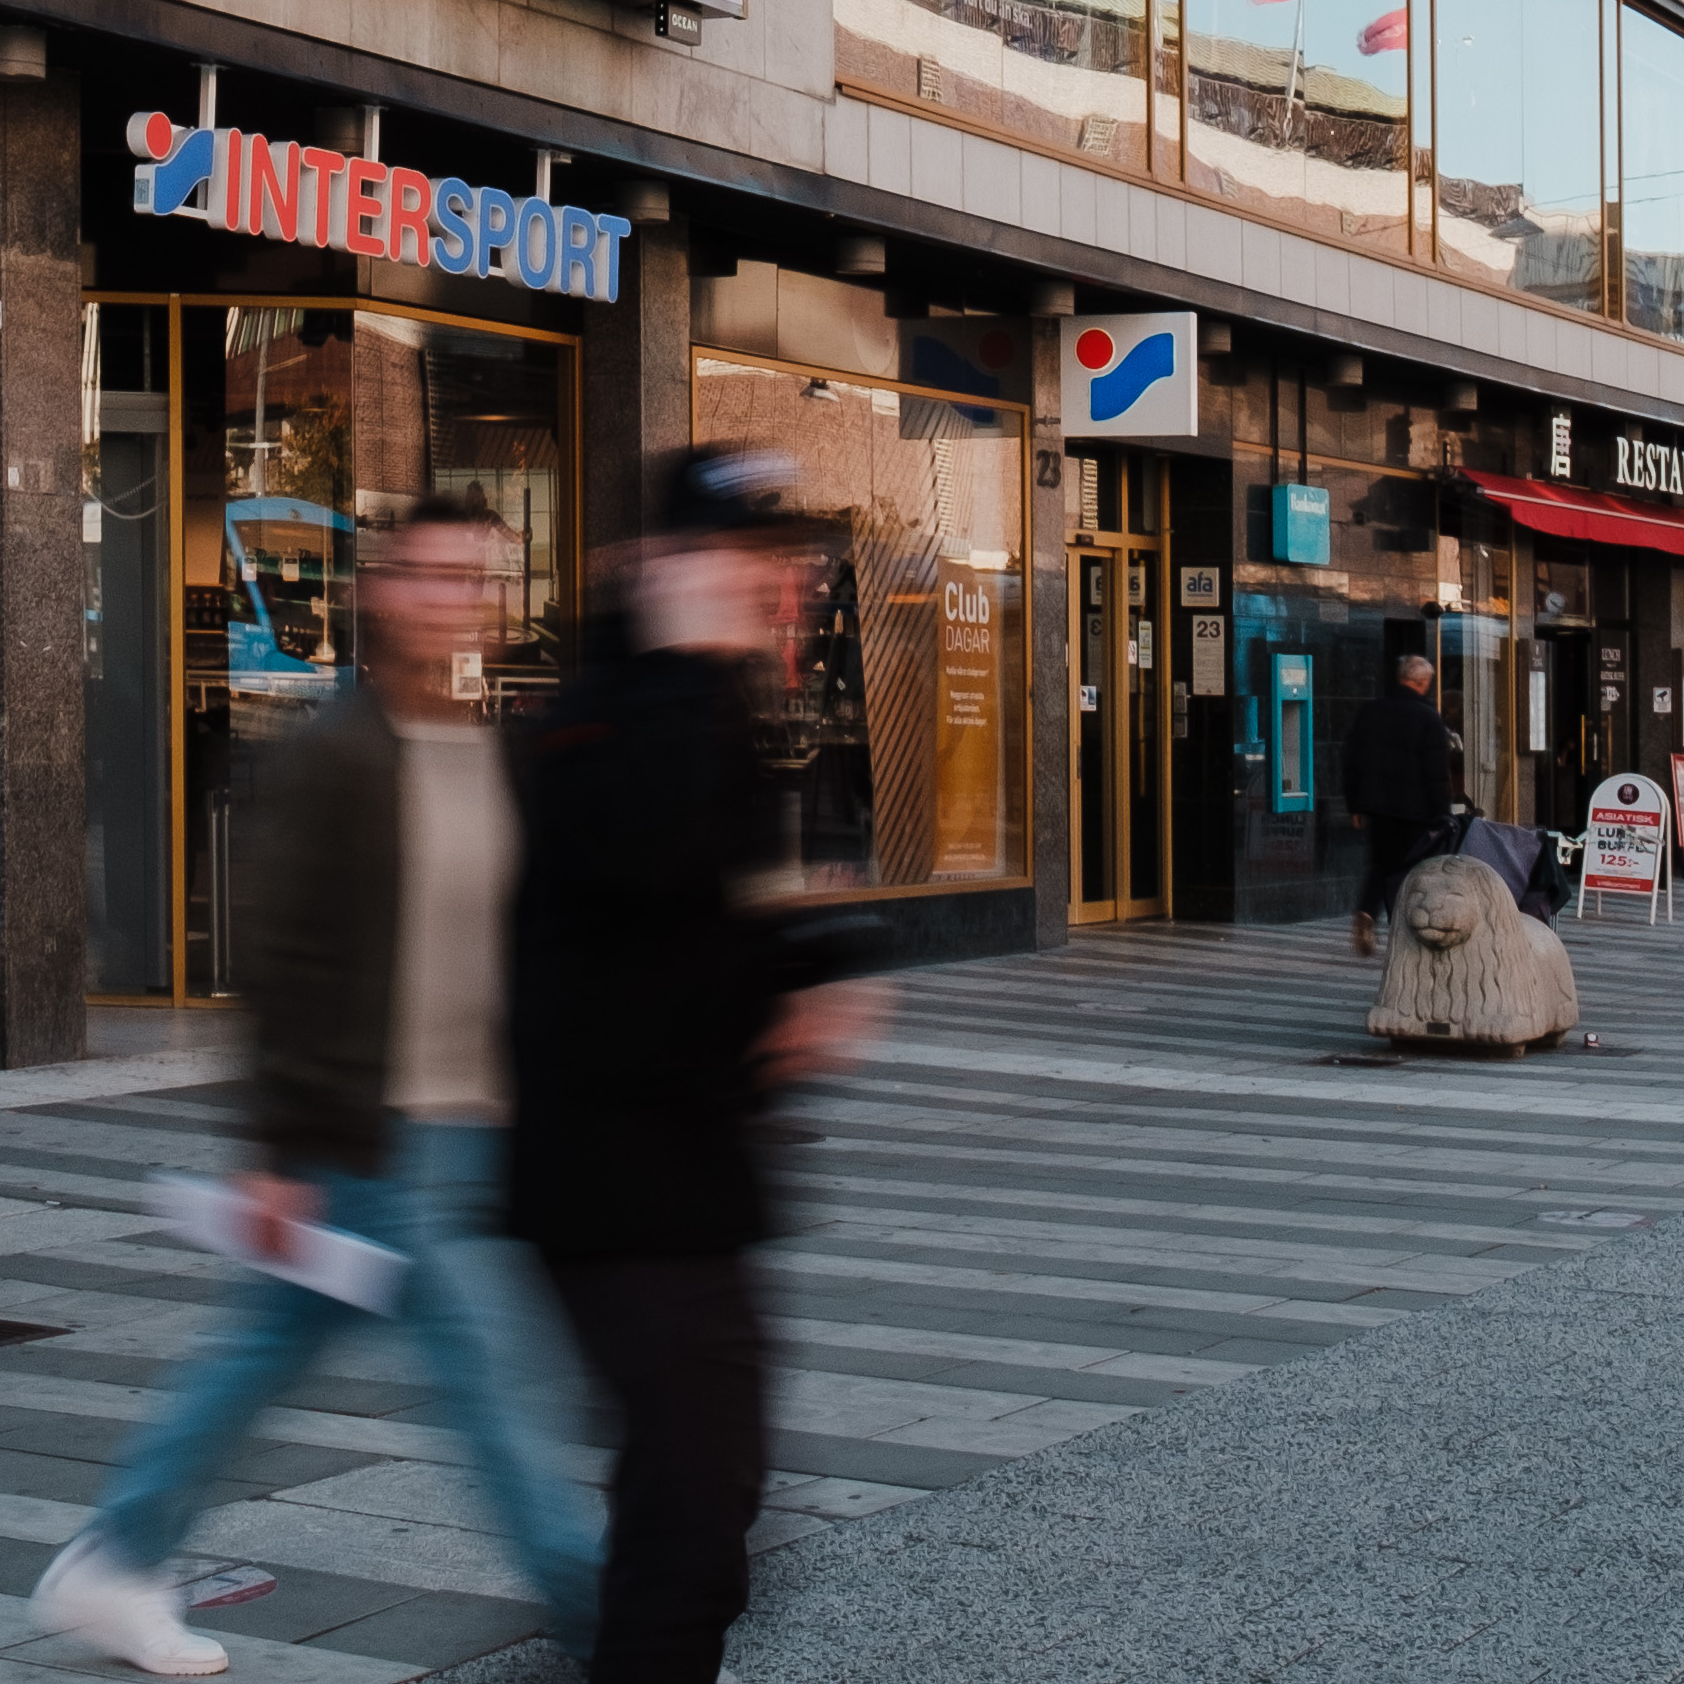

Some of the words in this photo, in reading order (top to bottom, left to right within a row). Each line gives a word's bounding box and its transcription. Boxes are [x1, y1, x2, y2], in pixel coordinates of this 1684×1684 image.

[671, 13, 698, 33] OCEAN
[216, 127, 632, 303] INTERSPORT
[1035, 448, 1062, 489] 23
[1186, 573, 1213, 594] afa
[944, 580, 990, 624] Club
[945, 624, 990, 654] DAGAR
[1196, 620, 1221, 638] 23
[1596, 811, 1654, 825] ASIATISK
